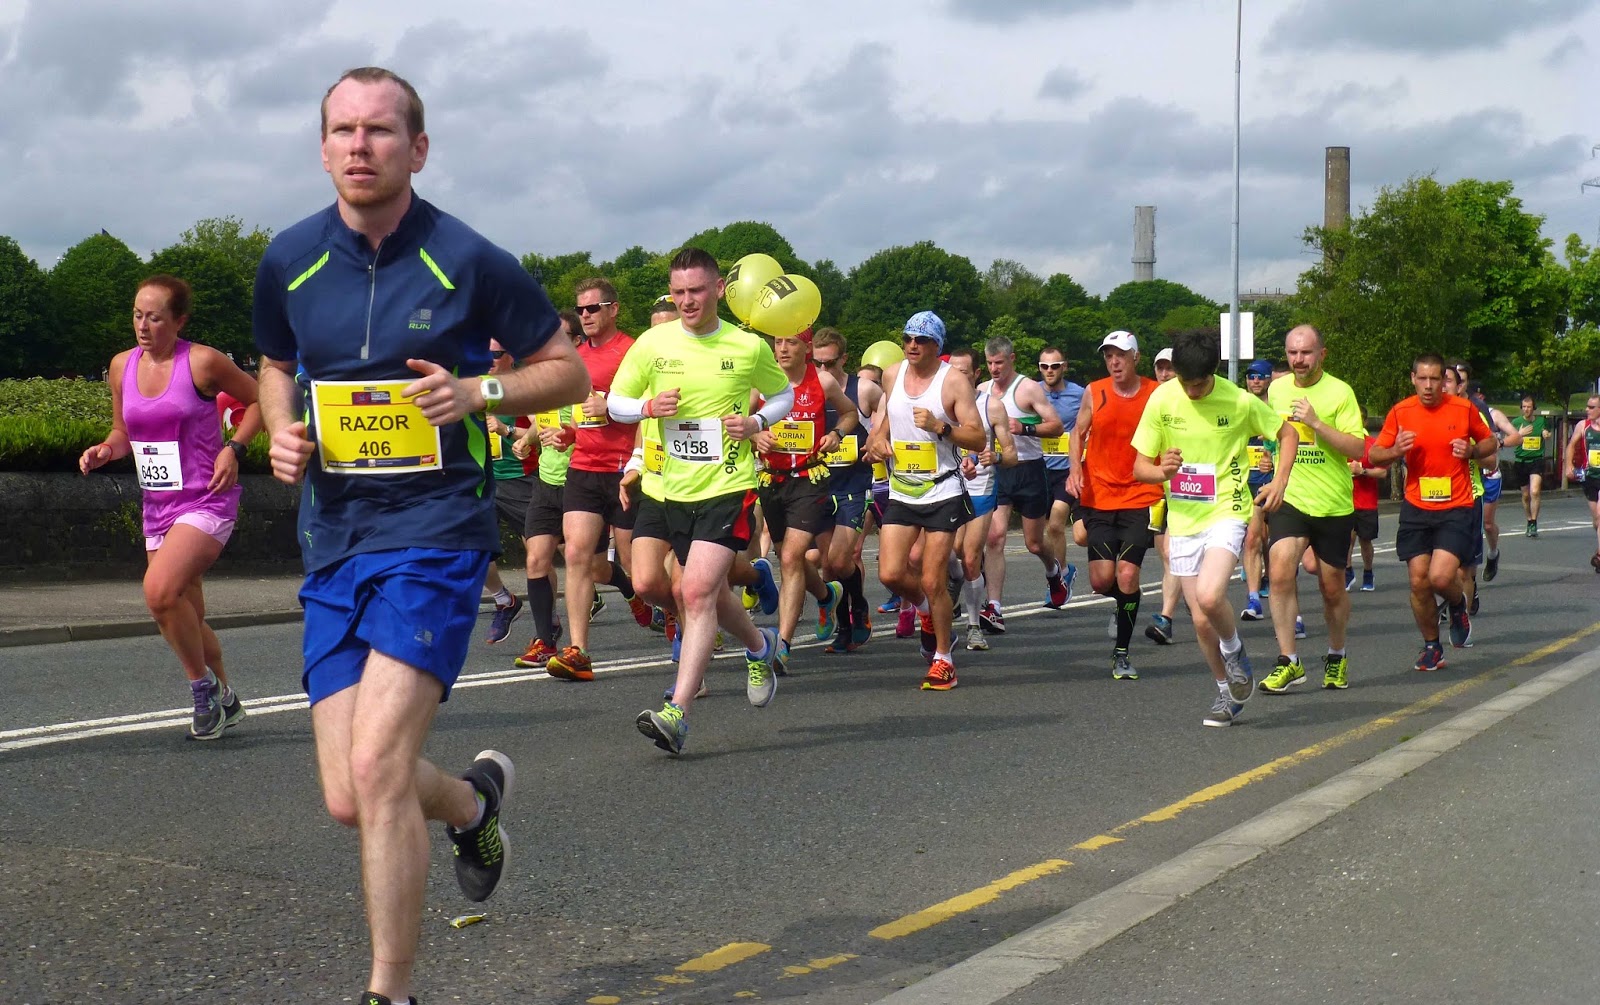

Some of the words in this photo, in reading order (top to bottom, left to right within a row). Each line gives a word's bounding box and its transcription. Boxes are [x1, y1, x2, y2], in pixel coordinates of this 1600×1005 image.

[339, 414, 411, 432] RAZOR
[777, 432, 806, 440] ADRIAN
[358, 440, 392, 457] 406
[673, 439, 709, 455] 6158
[141, 464, 169, 480] 6433
[1179, 481, 1203, 493] 8002
